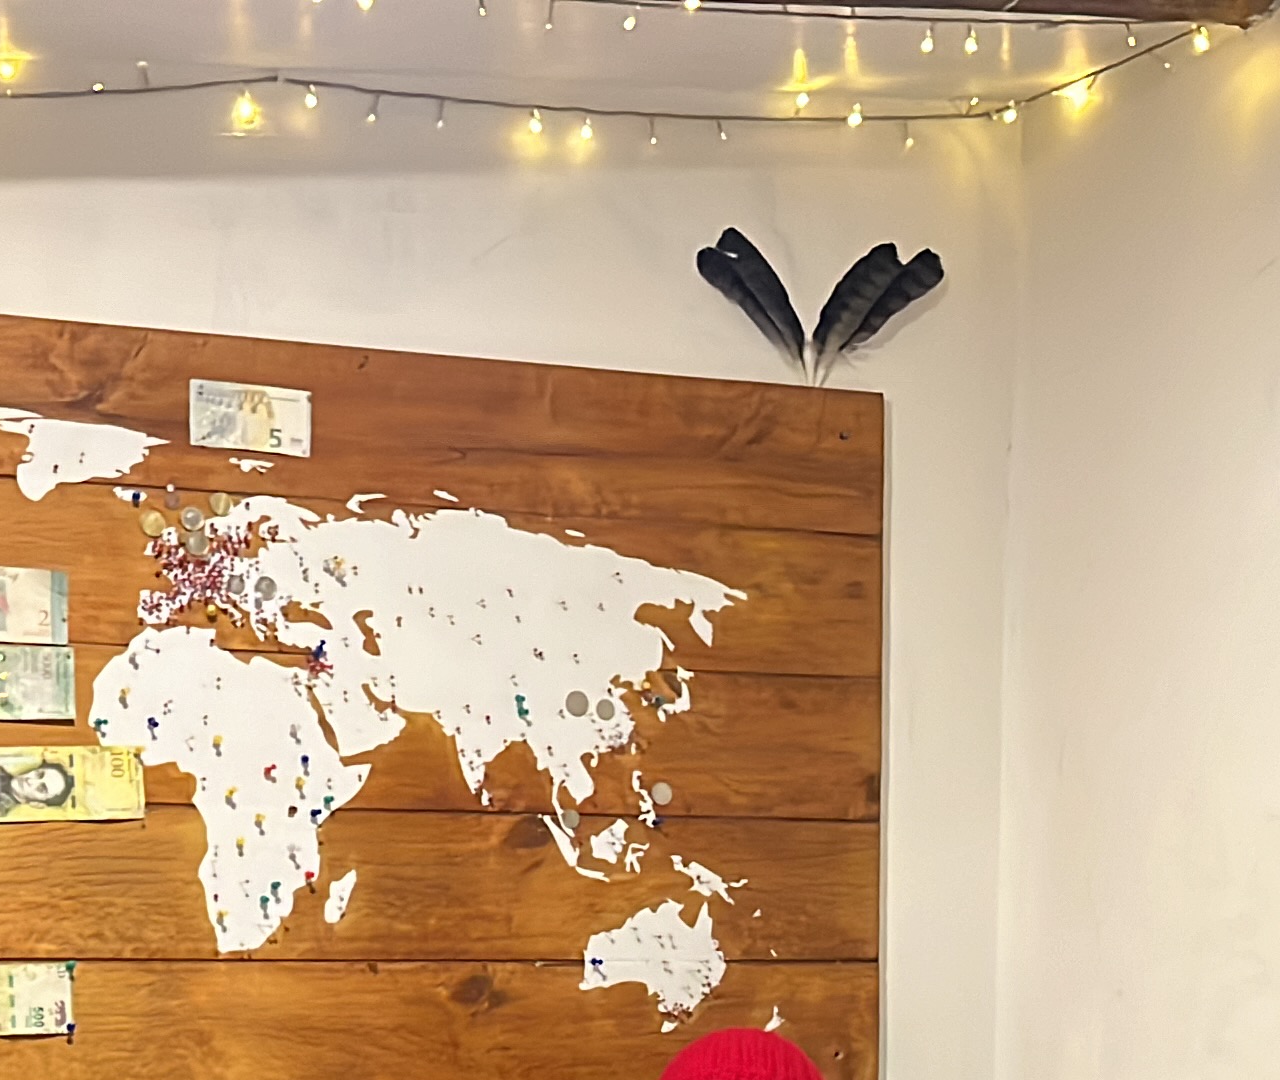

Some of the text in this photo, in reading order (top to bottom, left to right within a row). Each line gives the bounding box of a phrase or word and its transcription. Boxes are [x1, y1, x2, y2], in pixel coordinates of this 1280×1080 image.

[269, 428, 282, 448] 5
[38, 610, 50, 626] 2
[110, 751, 125, 778] 100
